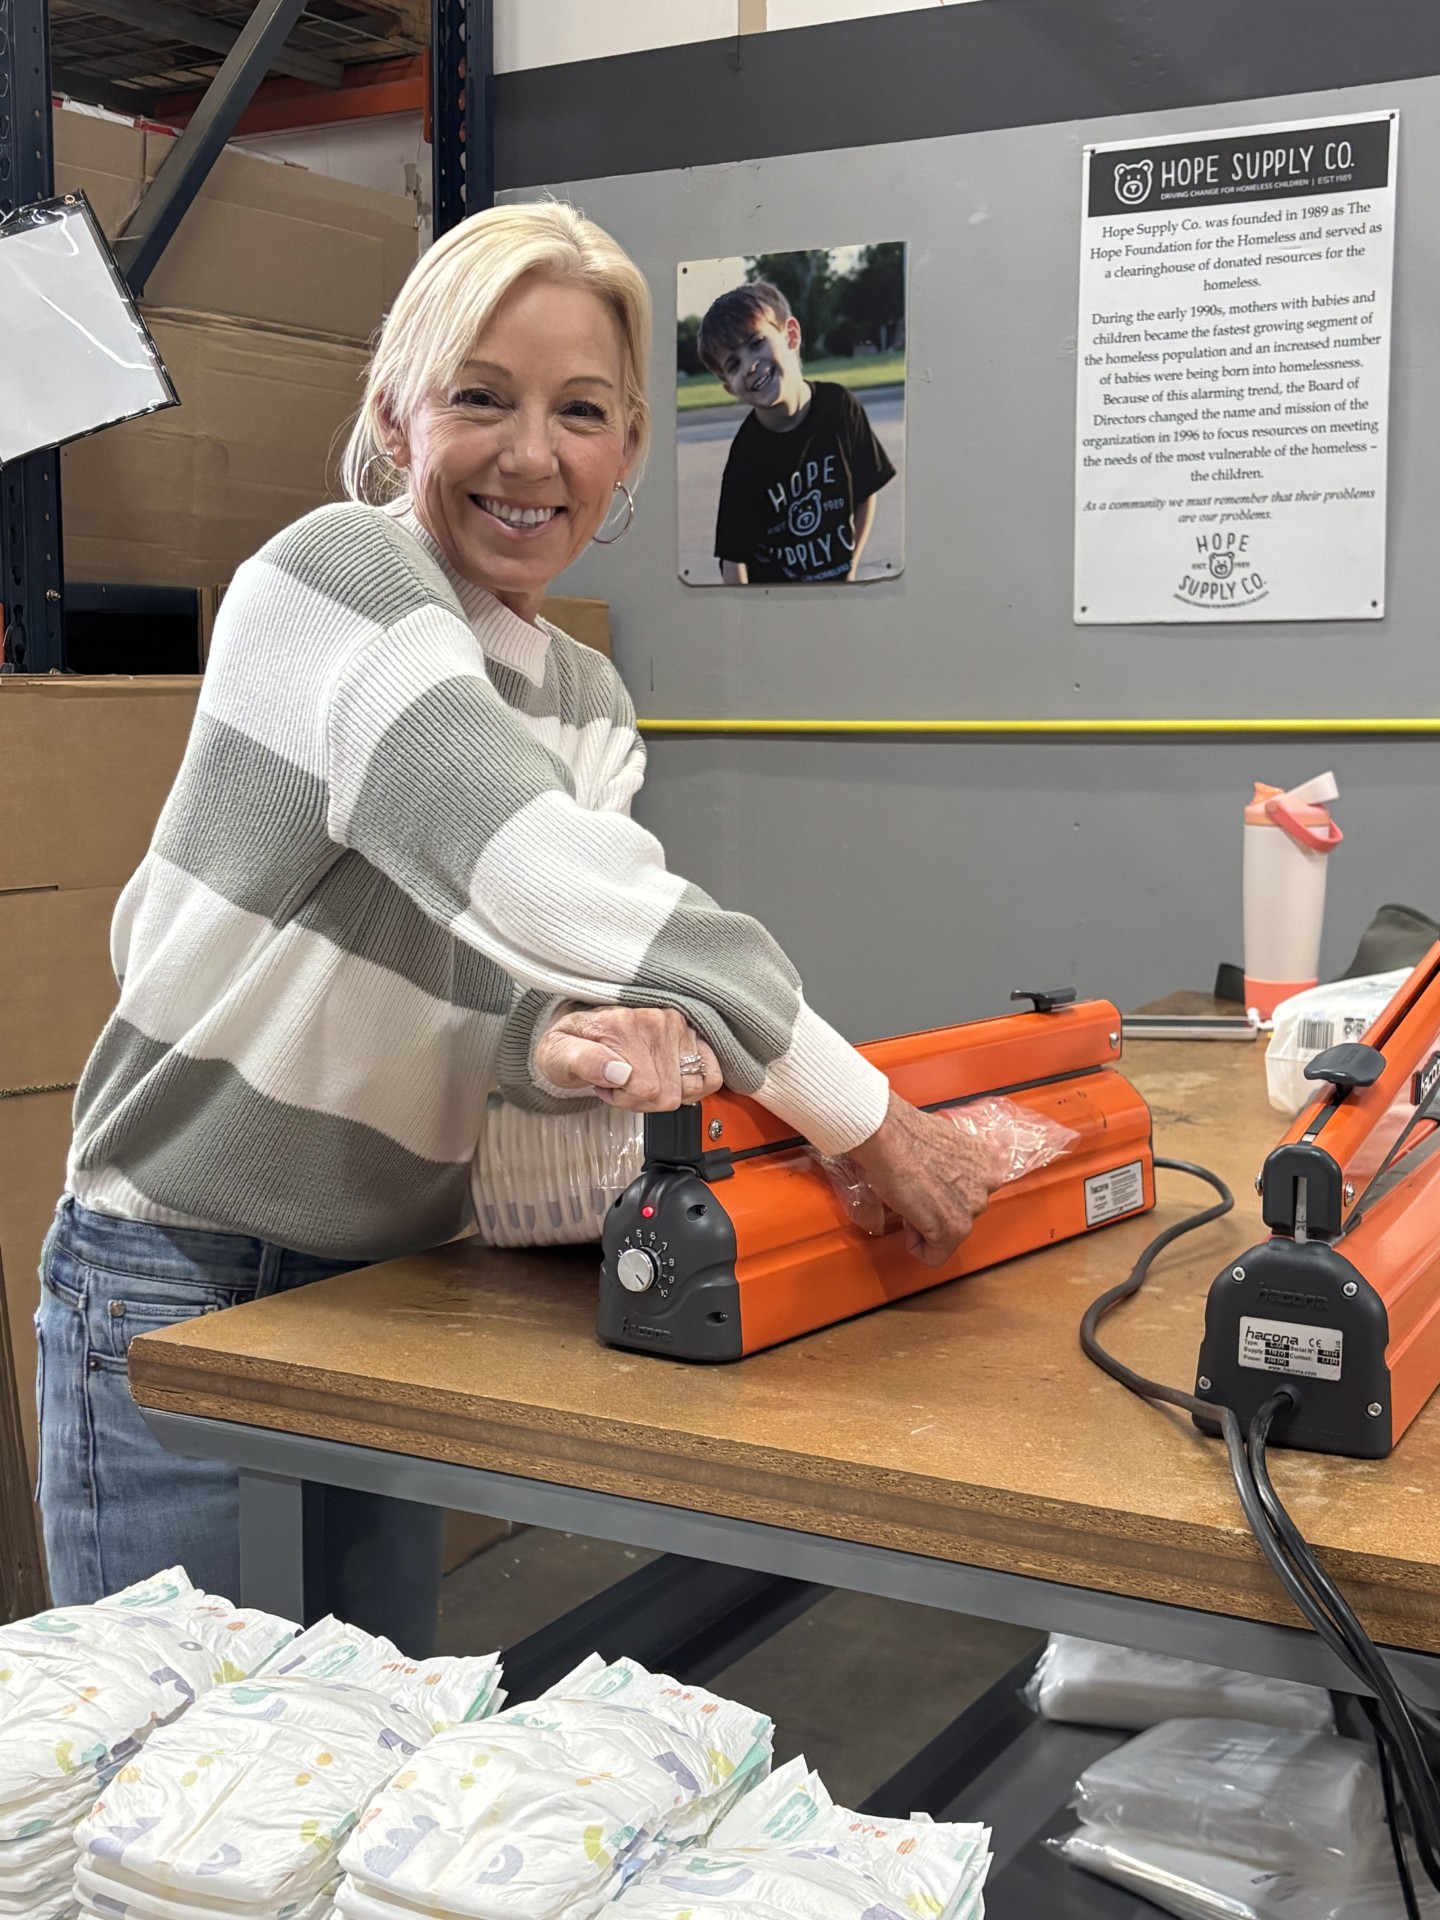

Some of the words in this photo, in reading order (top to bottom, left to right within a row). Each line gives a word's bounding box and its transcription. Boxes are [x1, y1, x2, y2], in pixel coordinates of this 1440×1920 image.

[1161, 154, 1220, 188] HOPE
[1231, 145, 1314, 181] SUPPLY
[1325, 141, 1355, 171] CO.
[1160, 190, 1189, 200] DRIVING
[1190, 187, 1219, 198] CHANGE
[1221, 185, 1236, 194] FOR
[1236, 182, 1273, 193] HOMELESS
[1274, 179, 1309, 189] CHILDREN
[1102, 225, 1134, 239] Hope
[1136, 221, 1178, 237] Supply
[1181, 218, 1201, 231] Co.
[1205, 217, 1229, 228] was
[1231, 209, 1283, 226] founded
[1285, 209, 1298, 221] in
[1302, 206, 1329, 219] 1989
[1331, 206, 1344, 217] as
[1347, 201, 1371, 214] The
[1089, 246, 1122, 261] Hope
[1124, 240, 1192, 256] Foundation
[1195, 238, 1213, 250] for
[1215, 236, 1235, 248] the
[1237, 230, 1296, 247] Homeless
[1298, 226, 1322, 240] and
[1324, 221, 1366, 238] served
[1368, 223, 1382, 233] as
[1104, 270, 1112, 278] a
[1113, 261, 1196, 278] clearinghouse
[1197, 257, 1211, 271] of
[1212, 253, 1263, 269] donated
[1264, 250, 1323, 265] resources
[1324, 246, 1344, 259] for
[1345, 244, 1366, 257] the
[1202, 276, 1262, 291] homeless.
[1091, 311, 1134, 326] During
[1135, 309, 1156, 321] the
[1156, 306, 1188, 322] early
[1190, 304, 1226, 317] 1990s,
[1228, 300, 1278, 314] mothers
[1280, 296, 1309, 310] with
[1311, 293, 1350, 307] babies
[1352, 289, 1376, 303] and
[1092, 331, 1141, 345] children
[1144, 329, 1188, 341] became
[1190, 325, 1210, 338] the
[1212, 323, 1250, 336] fastest
[1252, 319, 1304, 337] growing
[1306, 314, 1358, 332] segment
[1360, 311, 1373, 324] of
[1084, 353, 1103, 365] the
[1105, 350, 1160, 364] homeless
[1161, 346, 1227, 364] population
[1229, 342, 1253, 356] and
[1255, 344, 1271, 354] an
[1273, 336, 1330, 352] increased
[1332, 333, 1382, 348] number
[1099, 372, 1112, 385] of
[1114, 371, 1151, 384] babies
[1153, 371, 1183, 381] were
[1185, 367, 1219, 382] being
[1221, 365, 1250, 377] born
[1252, 363, 1277, 375] into
[1278, 358, 1363, 373] homelessness.
[1103, 393, 1150, 405] Because
[1151, 389, 1164, 402] of
[1166, 389, 1189, 401] this
[1190, 386, 1245, 401] alarming
[1247, 382, 1283, 396] trend,
[1285, 381, 1305, 393] the
[1308, 377, 1344, 392] Board
[1346, 376, 1359, 389] of
[1093, 414, 1146, 426] Directors
[1148, 408, 1198, 425] changed
[1201, 407, 1221, 419] the
[1222, 408, 1256, 418] name
[1258, 403, 1281, 416] and
[1284, 401, 1331, 414] mission
[1333, 398, 1346, 411] of
[1349, 397, 1369, 410] the
[1081, 432, 1156, 450] organization
[1157, 431, 1171, 442] in
[1173, 429, 1200, 442] 1996
[1202, 429, 1215, 440] to
[1216, 427, 1250, 439] focus
[1251, 425, 1309, 437] resources
[1310, 424, 1327, 434] on
[1329, 419, 1379, 434] meeting
[1083, 455, 1102, 467] the
[1103, 453, 1138, 465] needs
[1139, 451, 1152, 464] of
[1154, 451, 1174, 463] the
[1176, 451, 1206, 462] most
[1208, 445, 1272, 460] vulnerable
[1273, 444, 1287, 456] of
[1289, 443, 1309, 456] the
[1311, 440, 1367, 455] homeless
[767, 455, 836, 513] HOPE
[1190, 470, 1210, 481] the
[1211, 467, 1264, 480] children.
[1083, 500, 1097, 511] As
[1098, 502, 1107, 510] a
[1108, 498, 1166, 510] community
[1168, 498, 1184, 507] we
[1185, 496, 1212, 506] must
[1213, 492, 1269, 505] remember
[1270, 491, 1293, 502] that
[1294, 490, 1322, 501] their
[1322, 487, 1375, 503] problems
[1178, 514, 1197, 522] are
[1198, 513, 1218, 522] our
[1219, 508, 1271, 524] problems.
[1196, 532, 1250, 553] HOPE
[1178, 574, 1236, 600] SUPPLY
[1241, 572, 1267, 595] CO.
[624, 1236, 631, 1245] 4
[636, 1229, 642, 1238] 5
[650, 1231, 656, 1240] 6
[661, 1241, 668, 1250] 7
[668, 1258, 675, 1267] 8
[668, 1275, 675, 1284] 9
[1245, 1325, 1299, 1346] hacona
